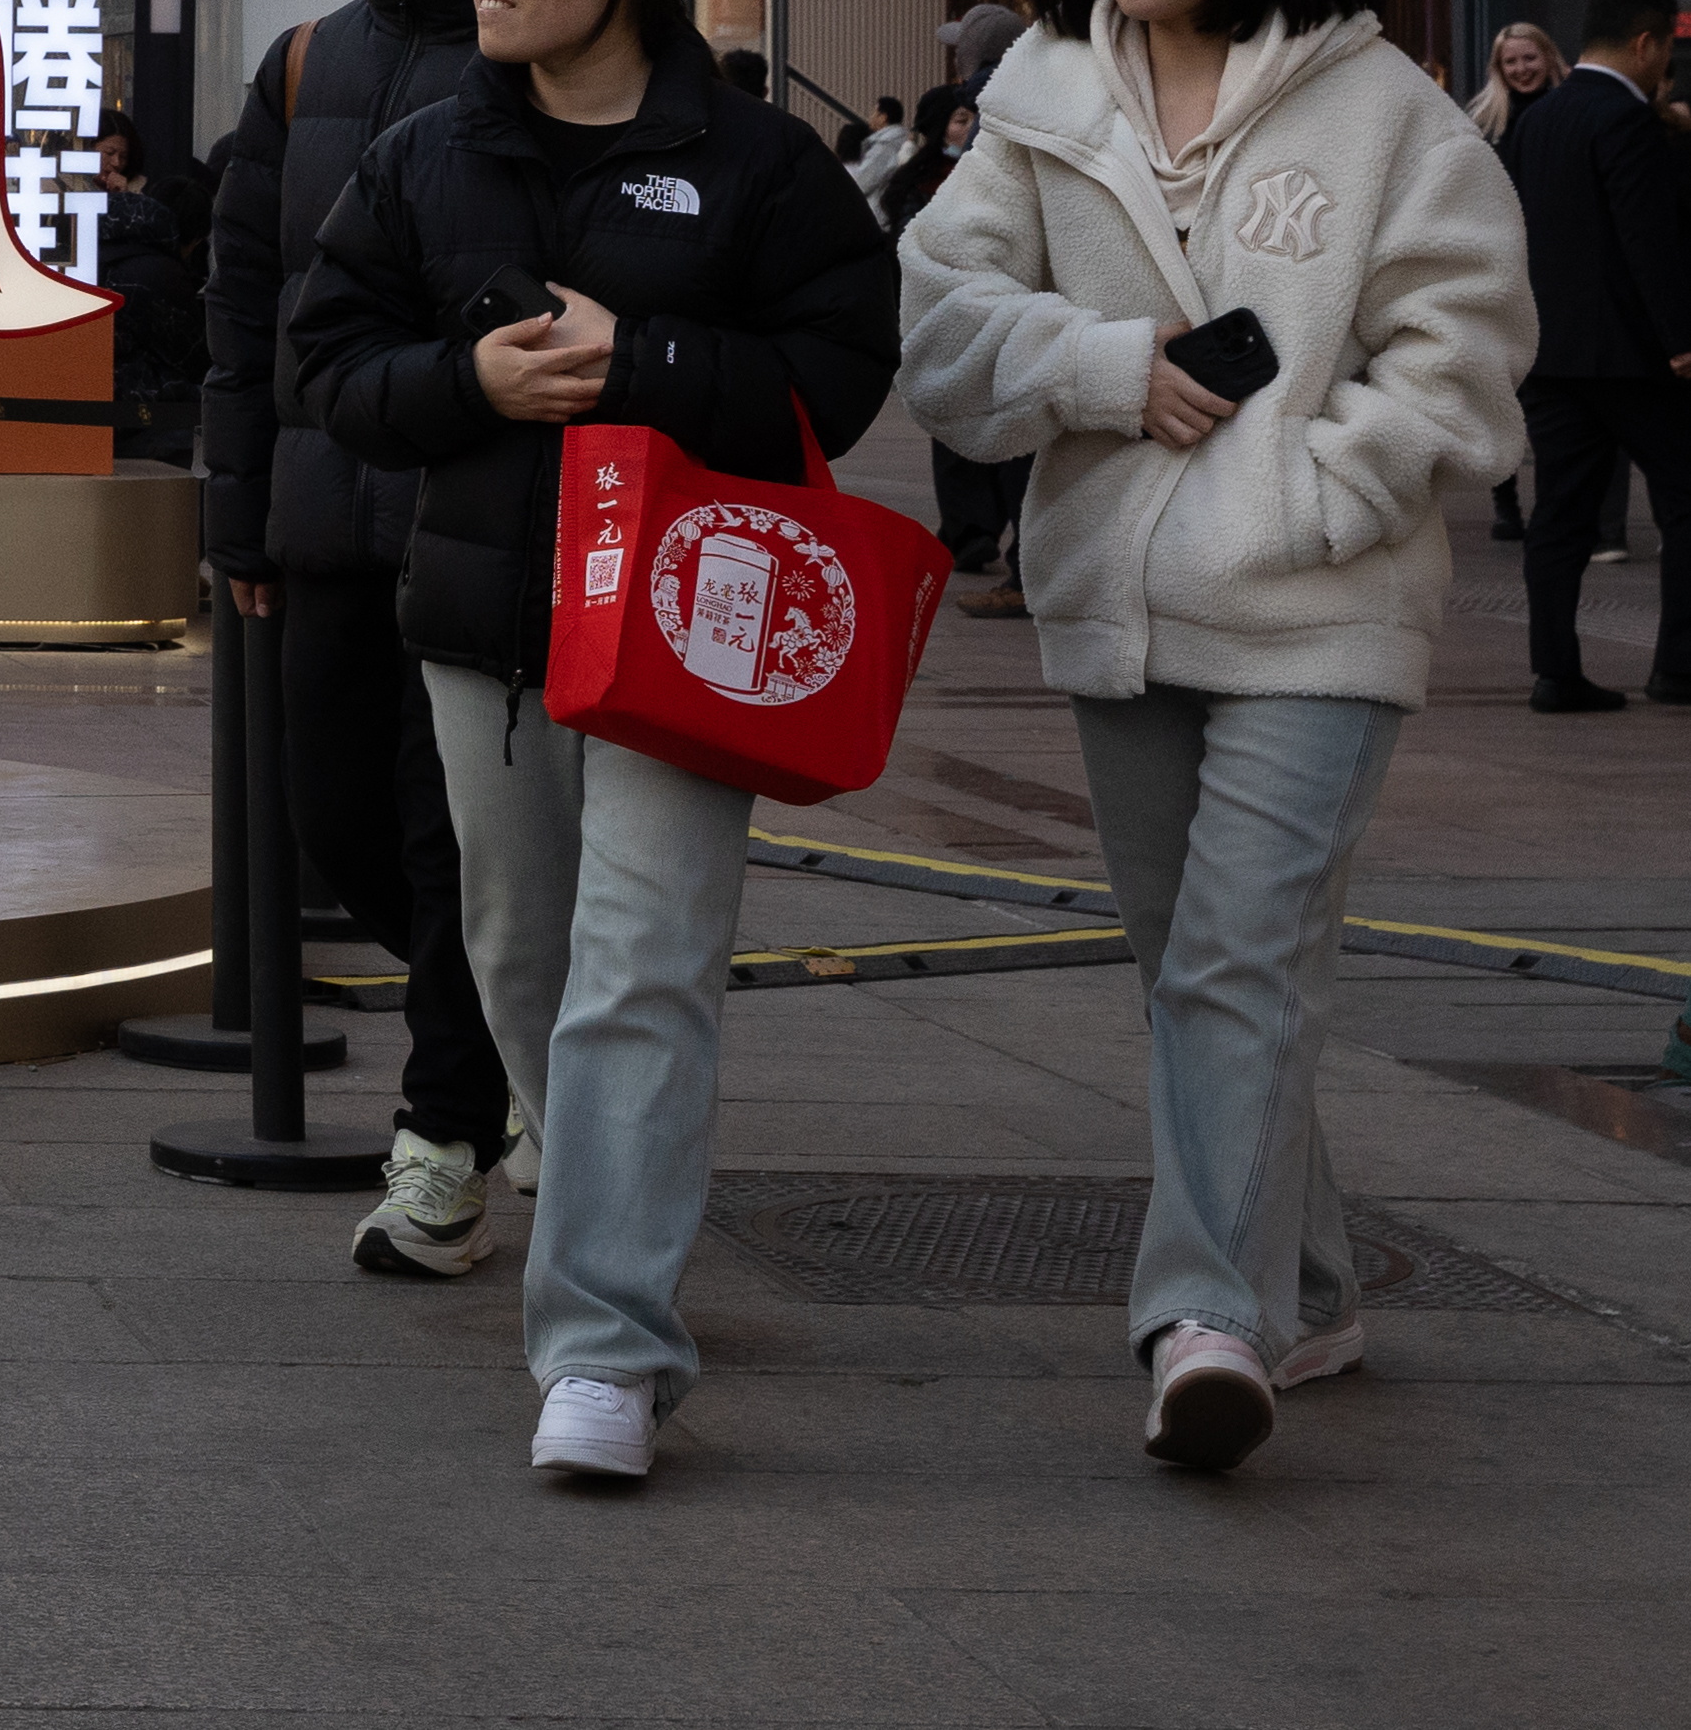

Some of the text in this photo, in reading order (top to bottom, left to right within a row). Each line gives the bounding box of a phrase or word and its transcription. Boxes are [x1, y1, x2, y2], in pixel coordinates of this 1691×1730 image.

[645, 173, 678, 189] THE
[620, 181, 677, 202] NORTH
[634, 195, 675, 212] FACE
[696, 595, 734, 612] LONGHAO
